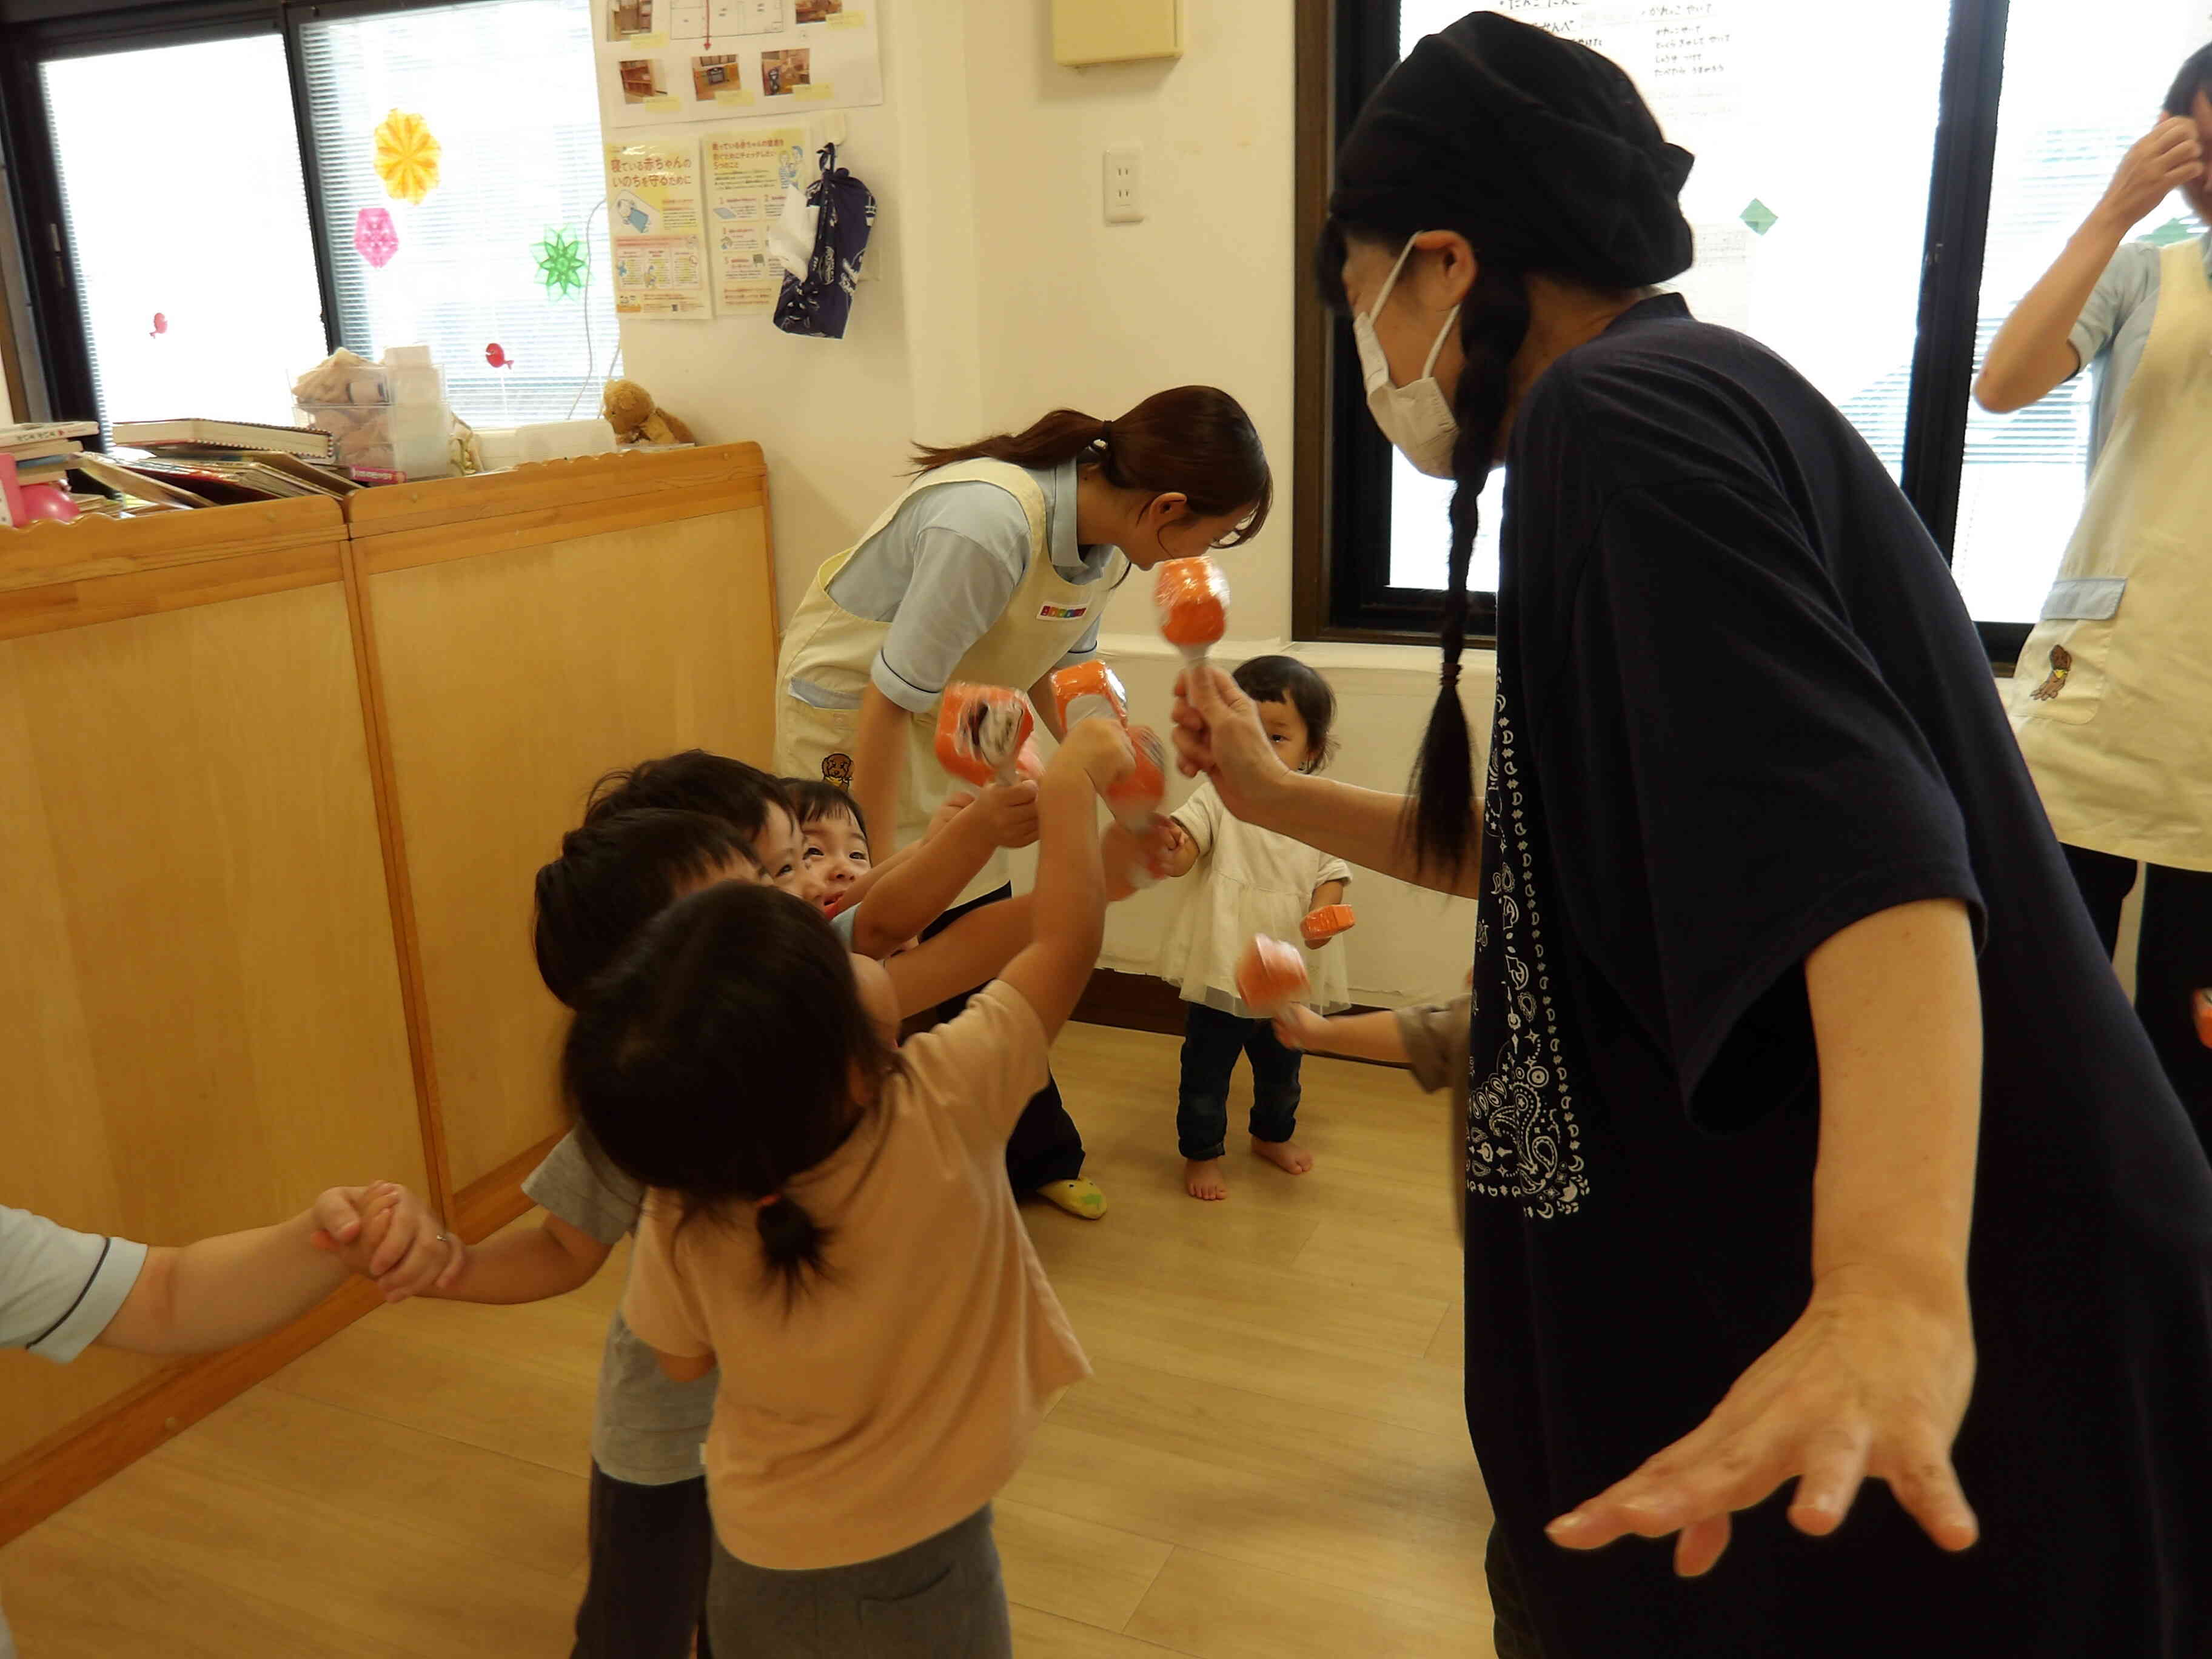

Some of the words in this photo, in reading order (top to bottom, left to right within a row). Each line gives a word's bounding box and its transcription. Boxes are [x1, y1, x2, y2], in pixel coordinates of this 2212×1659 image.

[612, 175, 692, 187] いのちを守るために
